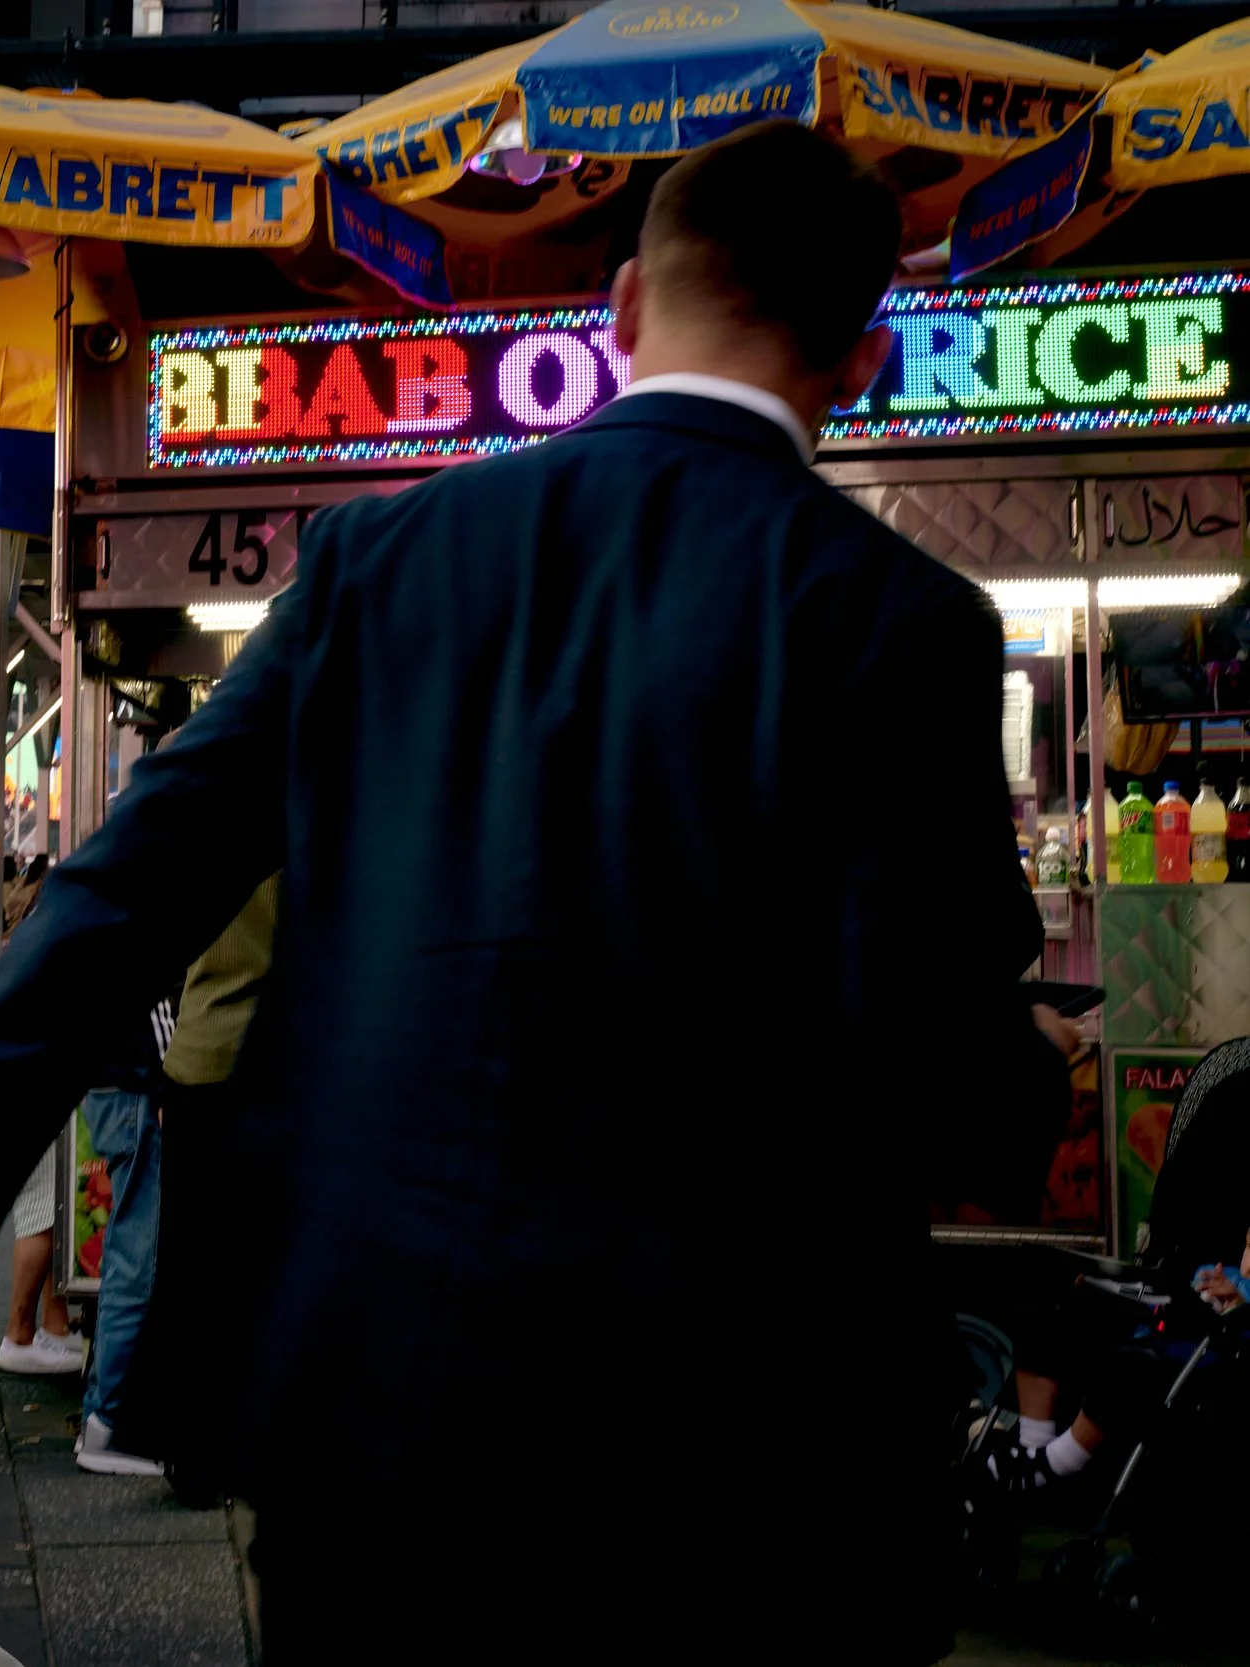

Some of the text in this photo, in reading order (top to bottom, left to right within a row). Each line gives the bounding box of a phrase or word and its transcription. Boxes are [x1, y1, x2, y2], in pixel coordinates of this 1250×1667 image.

[550, 103, 622, 129] WE'RE
[629, 99, 664, 126] ON
[693, 87, 754, 118] ROLL
[857, 67, 1099, 138] SABRET
[1131, 99, 1250, 161] SA
[317, 102, 499, 186] BRETT
[1018, 190, 1038, 223] ON
[888, 298, 1231, 412] RICE
[188, 509, 269, 586] 45
[1118, 486, 1240, 547] حلال
